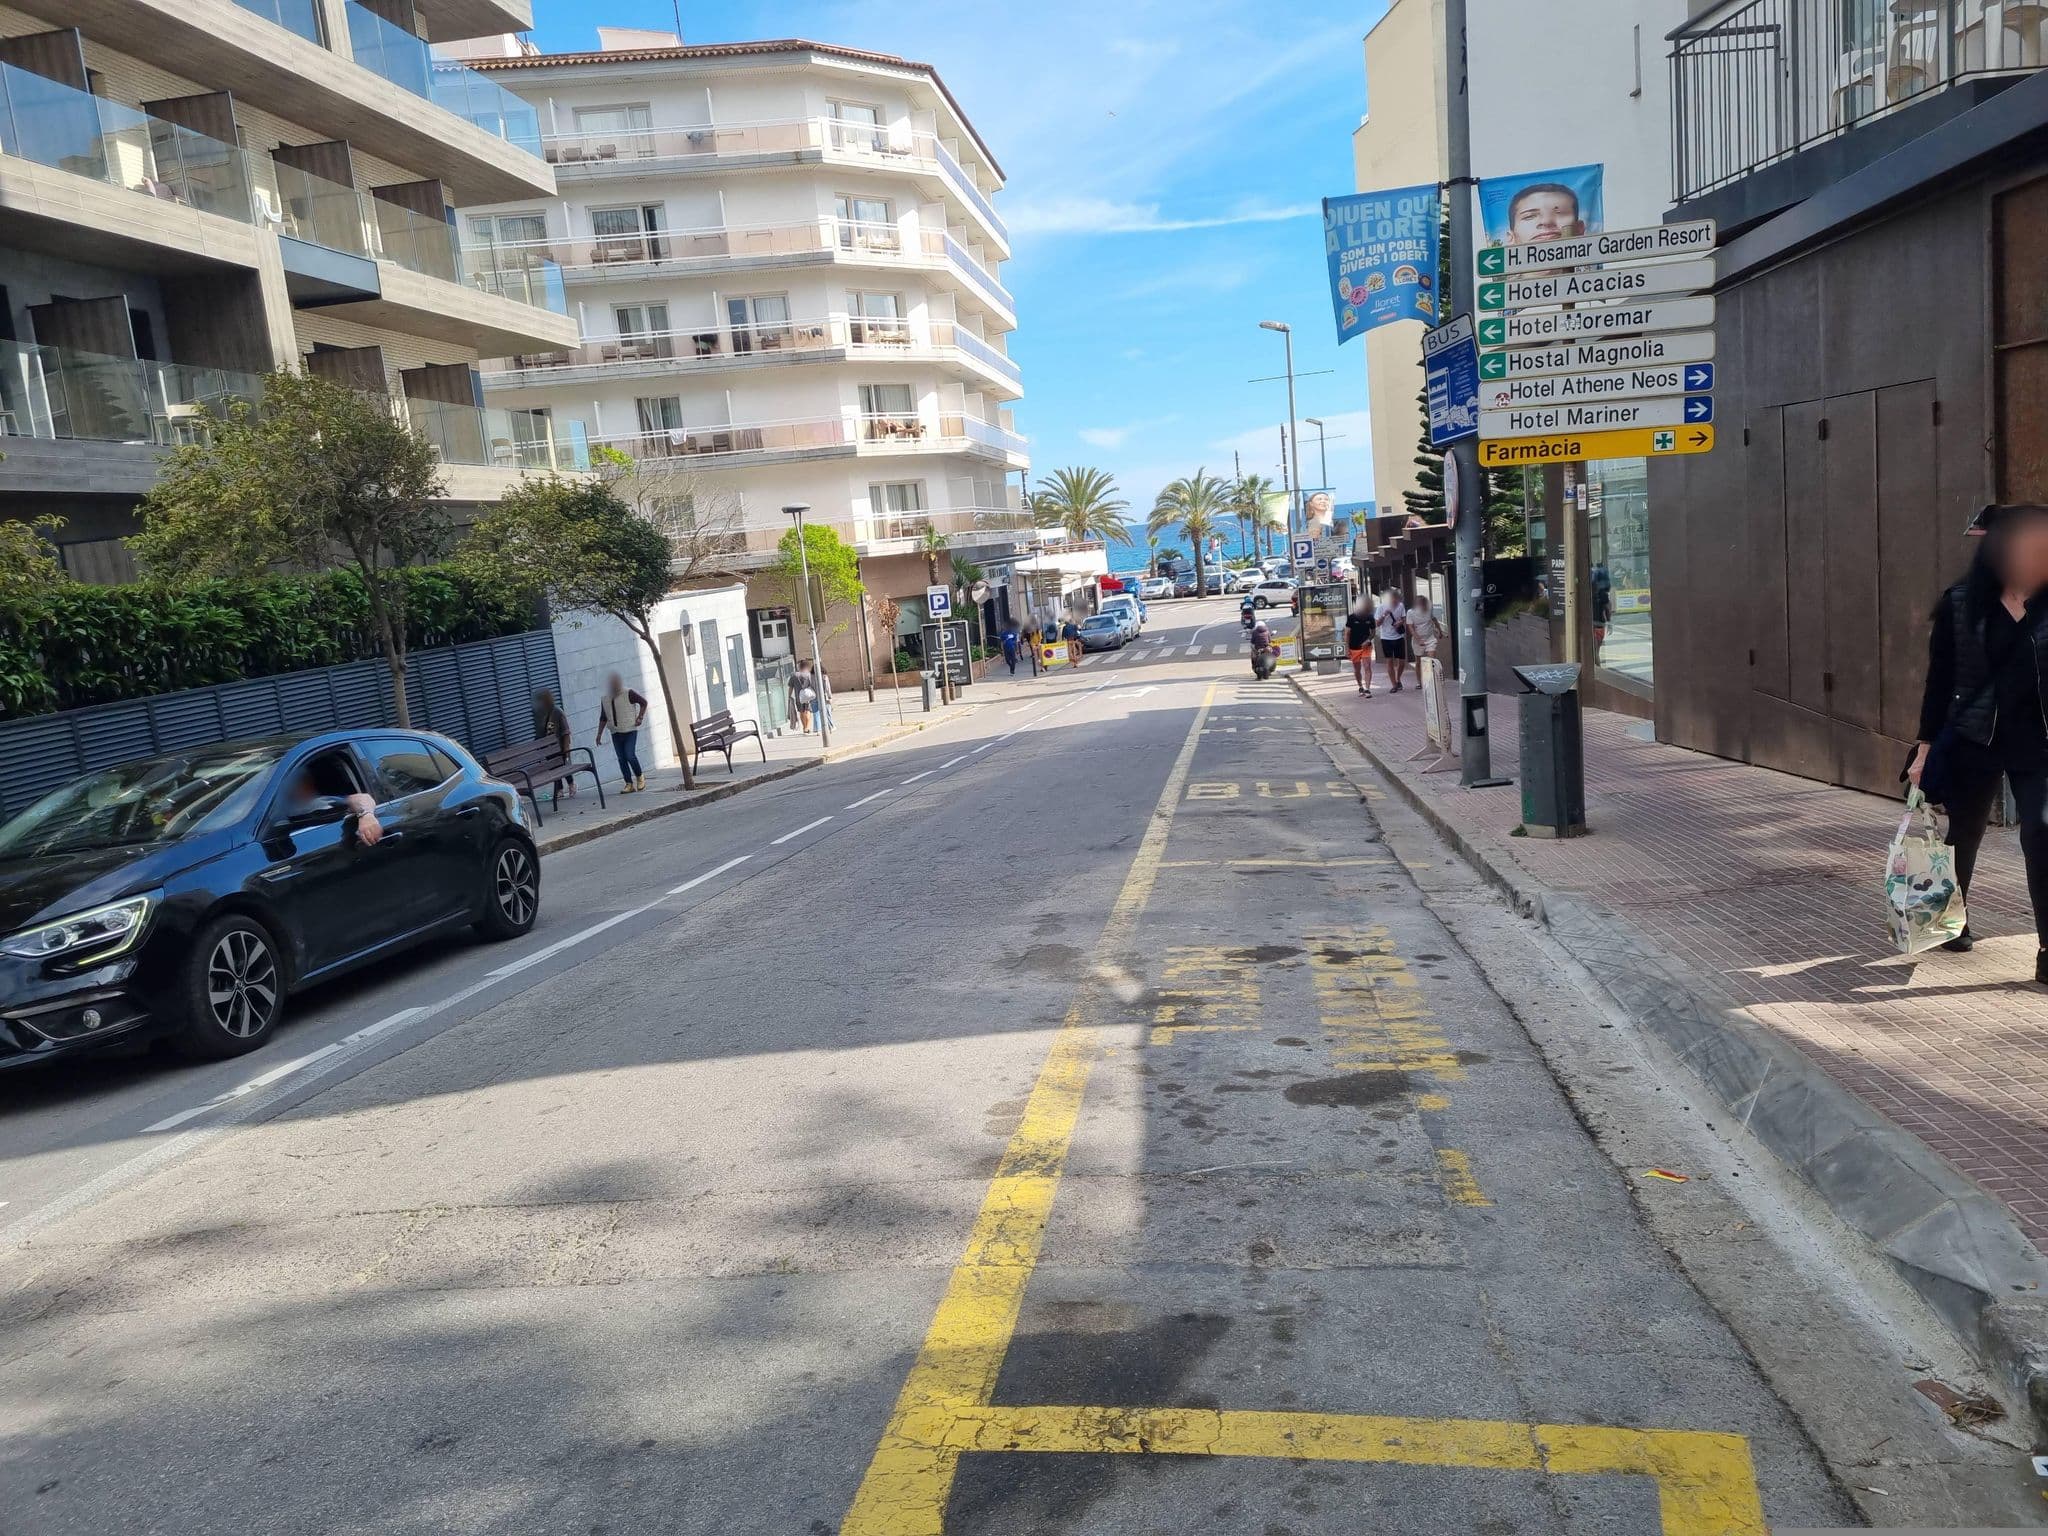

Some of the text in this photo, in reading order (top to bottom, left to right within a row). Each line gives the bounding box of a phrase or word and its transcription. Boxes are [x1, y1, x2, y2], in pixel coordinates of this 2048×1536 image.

[1324, 193, 1441, 231] DIUEN QUE
[1326, 215, 1442, 257] A LLORET
[1508, 224, 1711, 266] H. Rosamar Garden Resort
[1339, 250, 1430, 276] DIVERS I OBERT
[1340, 238, 1427, 264] SOM UN POBLE
[1508, 271, 1646, 301] Hotel Acacias
[1427, 323, 1461, 351] BUS
[1509, 315, 1557, 337] Hotel
[1509, 339, 1665, 371] Hostal Magnolia
[1510, 371, 1679, 400] Hotel Athene Neos
[1510, 405, 1640, 430] Hotel Mariner
[1486, 438, 1582, 462] Farmàcia
[1296, 542, 1310, 559] P
[931, 594, 946, 609] P
[1186, 782, 1388, 801] BUS
